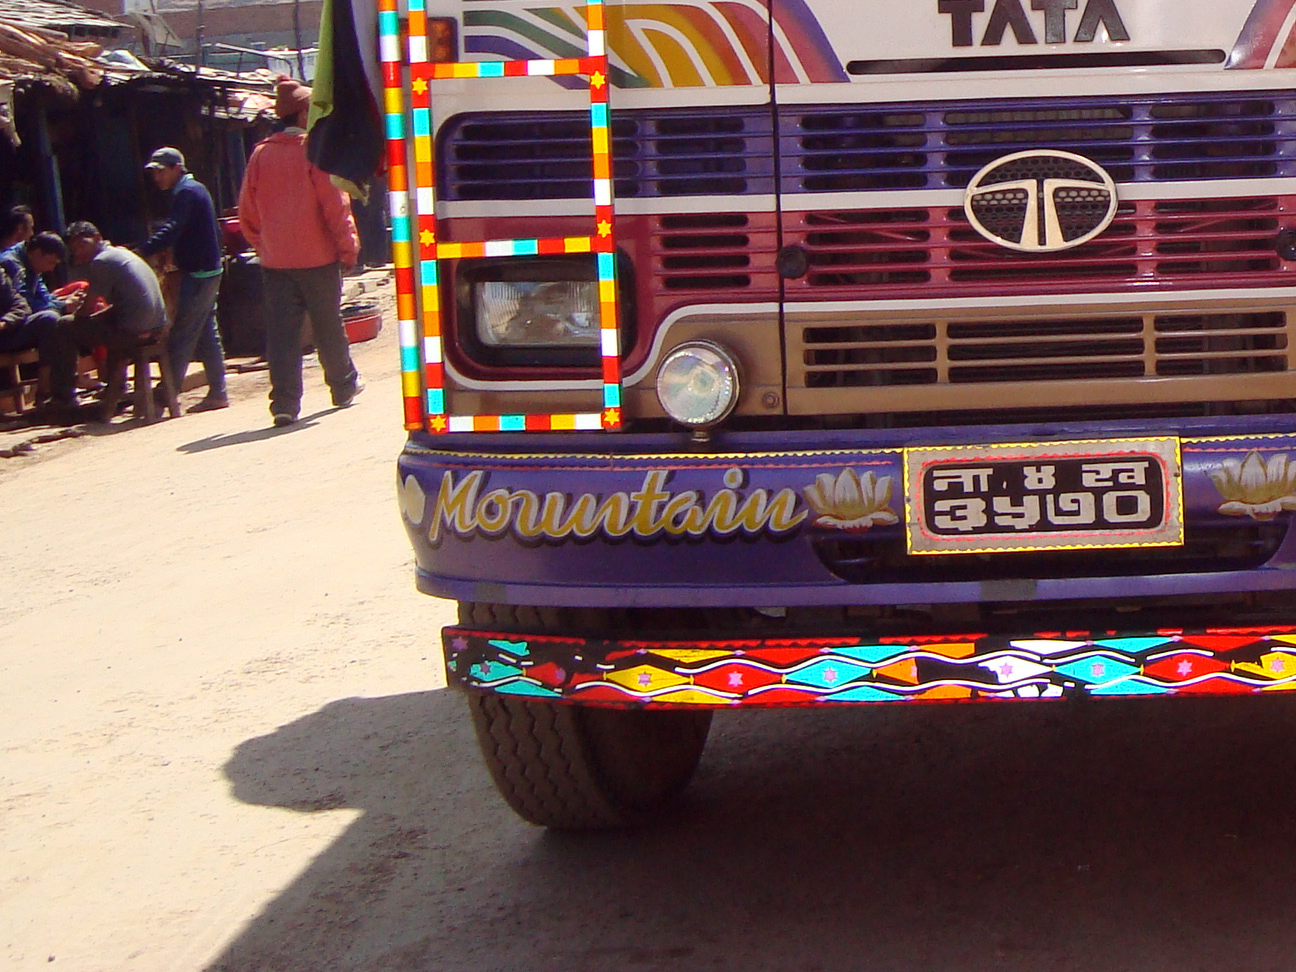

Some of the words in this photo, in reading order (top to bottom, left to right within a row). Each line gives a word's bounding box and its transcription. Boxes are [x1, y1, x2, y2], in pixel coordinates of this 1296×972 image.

[1082, 461, 1149, 488] ख
[428, 467, 809, 542] Mountain
[934, 490, 1150, 532] ३५७०
